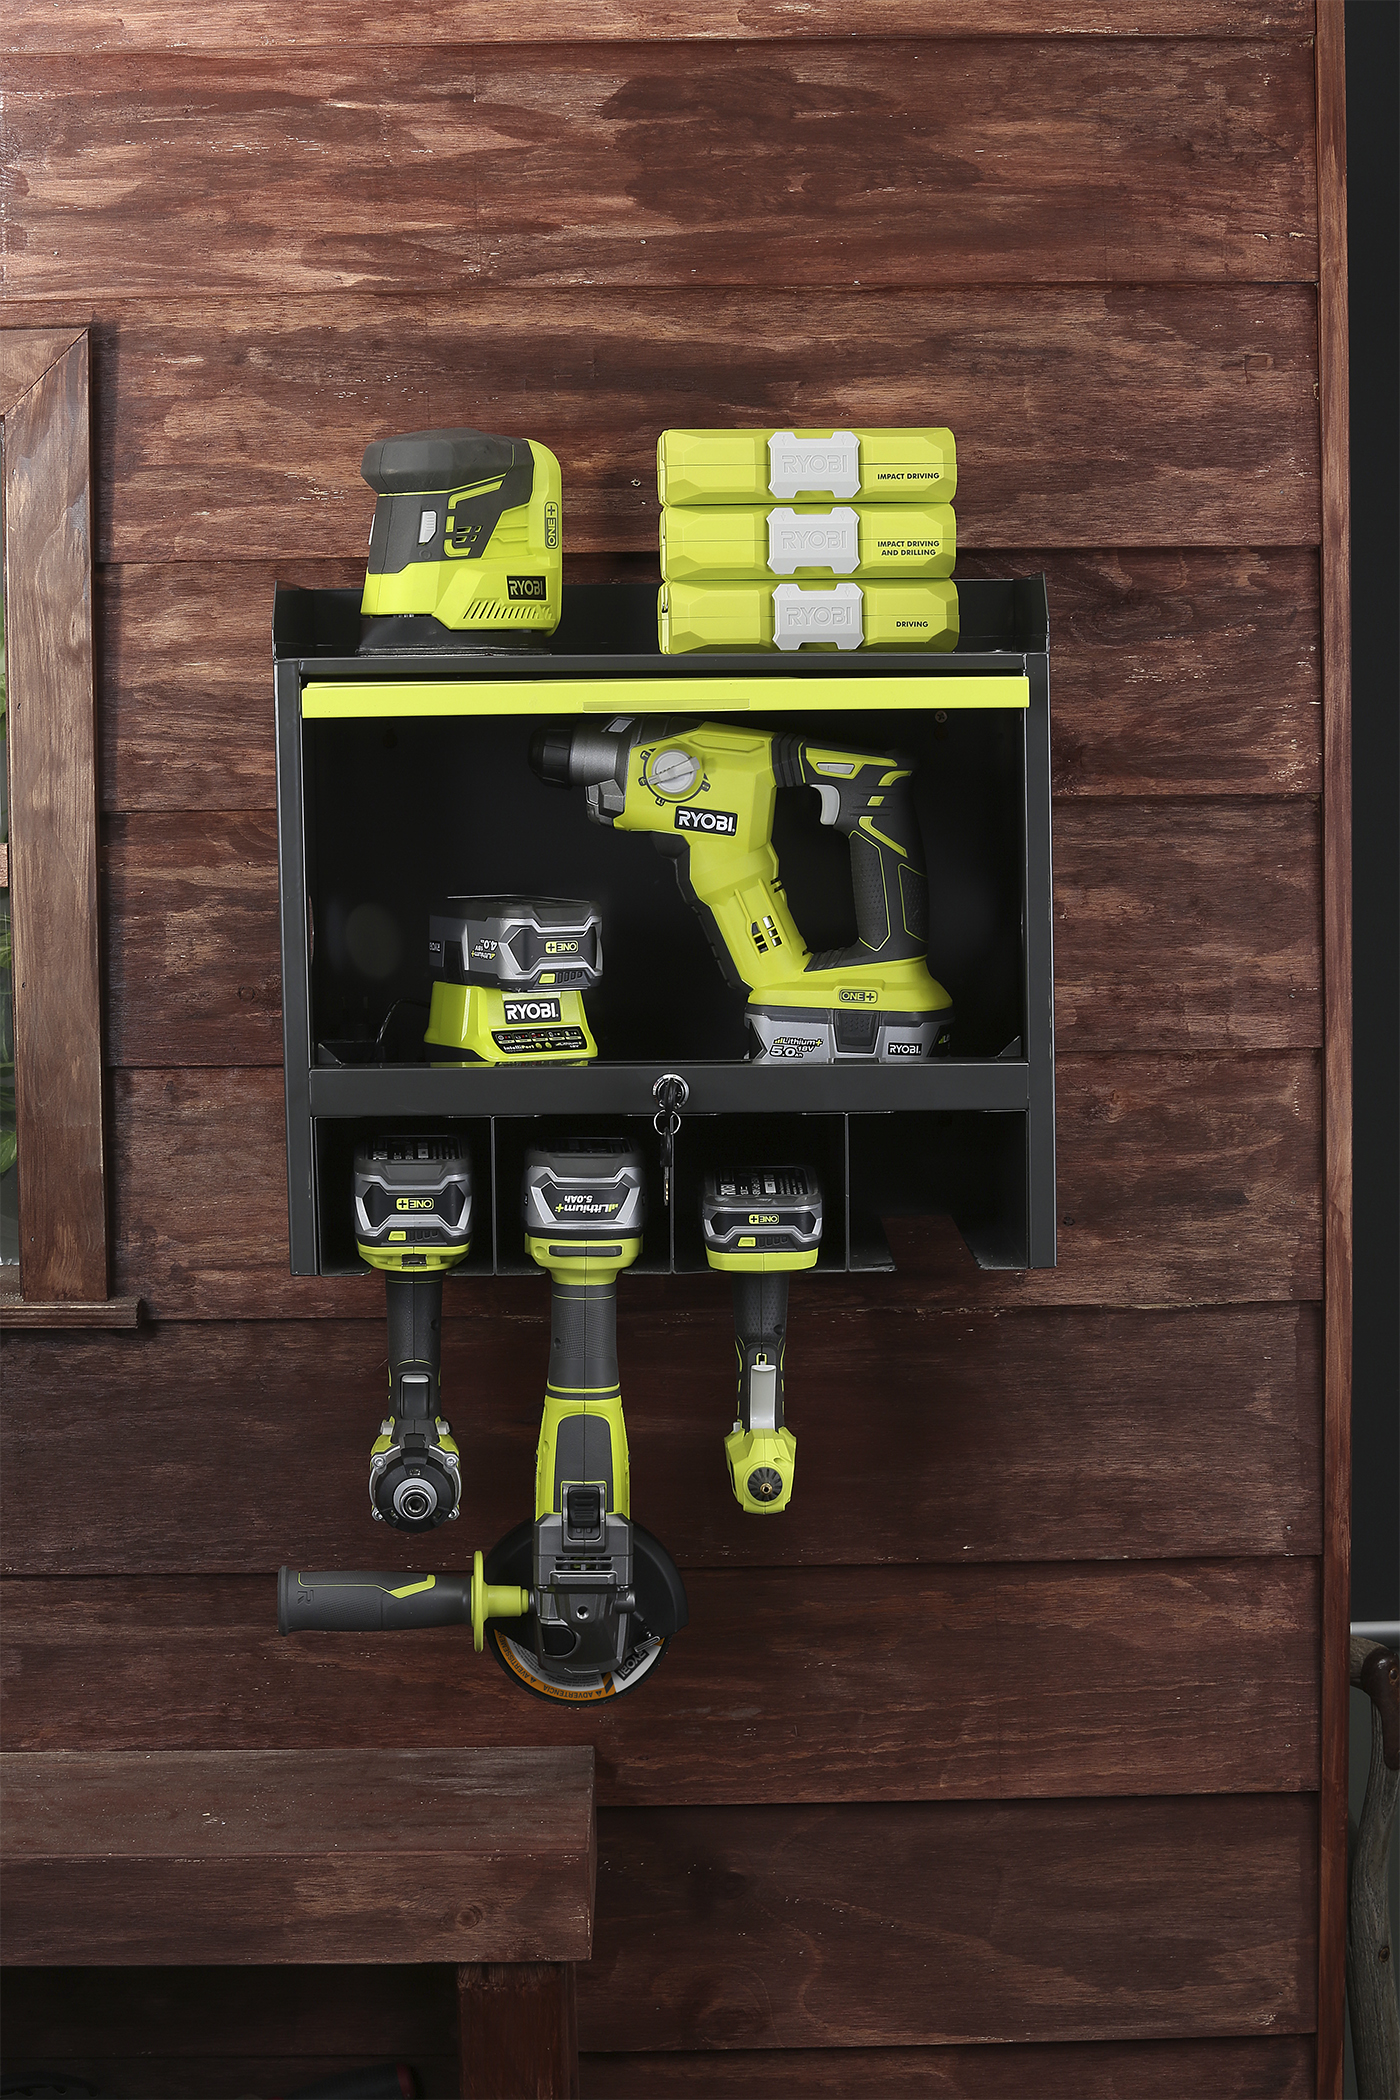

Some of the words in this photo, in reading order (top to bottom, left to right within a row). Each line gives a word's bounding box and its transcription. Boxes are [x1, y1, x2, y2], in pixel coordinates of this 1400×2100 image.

[781, 453, 848, 475] RYOBI
[906, 472, 940, 480] DRIVING
[780, 530, 847, 550] RYOBI
[906, 540, 940, 548] DRIVING
[508, 580, 544, 596] RYOBI
[786, 606, 852, 626] RYOBI
[841, 991, 875, 1002] ONE+
[397, 1199, 433, 1209] ONE+
[563, 1195, 593, 1203] 5.0Ah
[542, 1684, 593, 1699] ADVERTENCIA
